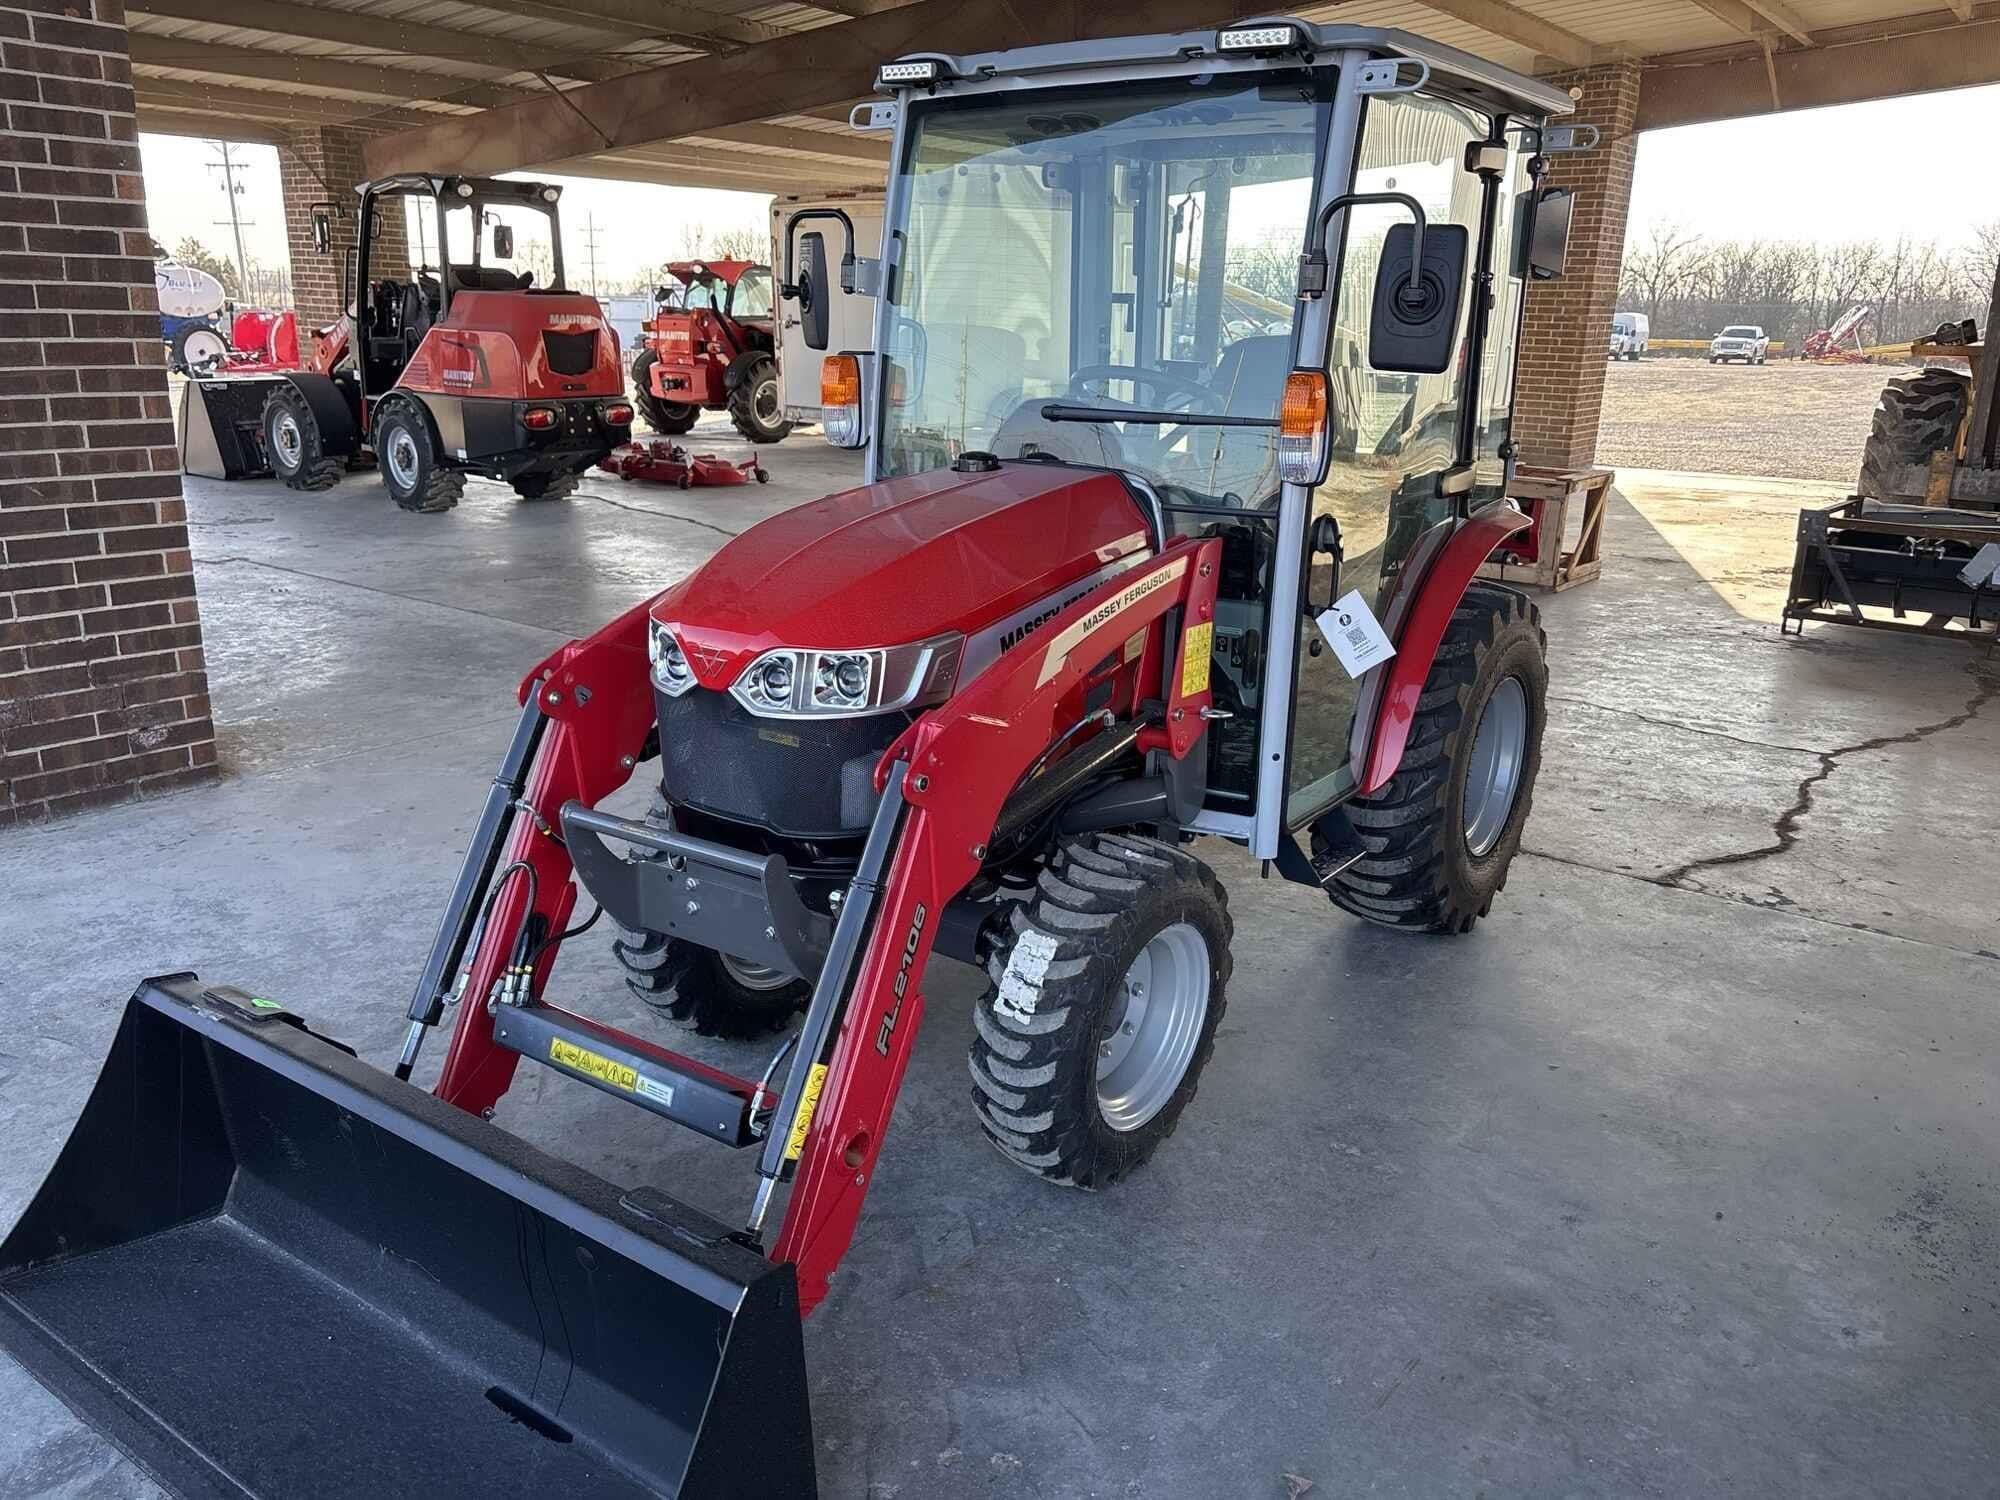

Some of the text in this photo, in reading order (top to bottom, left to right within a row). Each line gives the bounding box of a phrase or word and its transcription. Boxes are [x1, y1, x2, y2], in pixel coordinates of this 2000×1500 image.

[549, 314, 592, 325] MANITOU
[443, 369, 474, 381] MANITOU
[1083, 598, 1122, 632] MASSEY
[1124, 568, 1171, 605] FERGUSON
